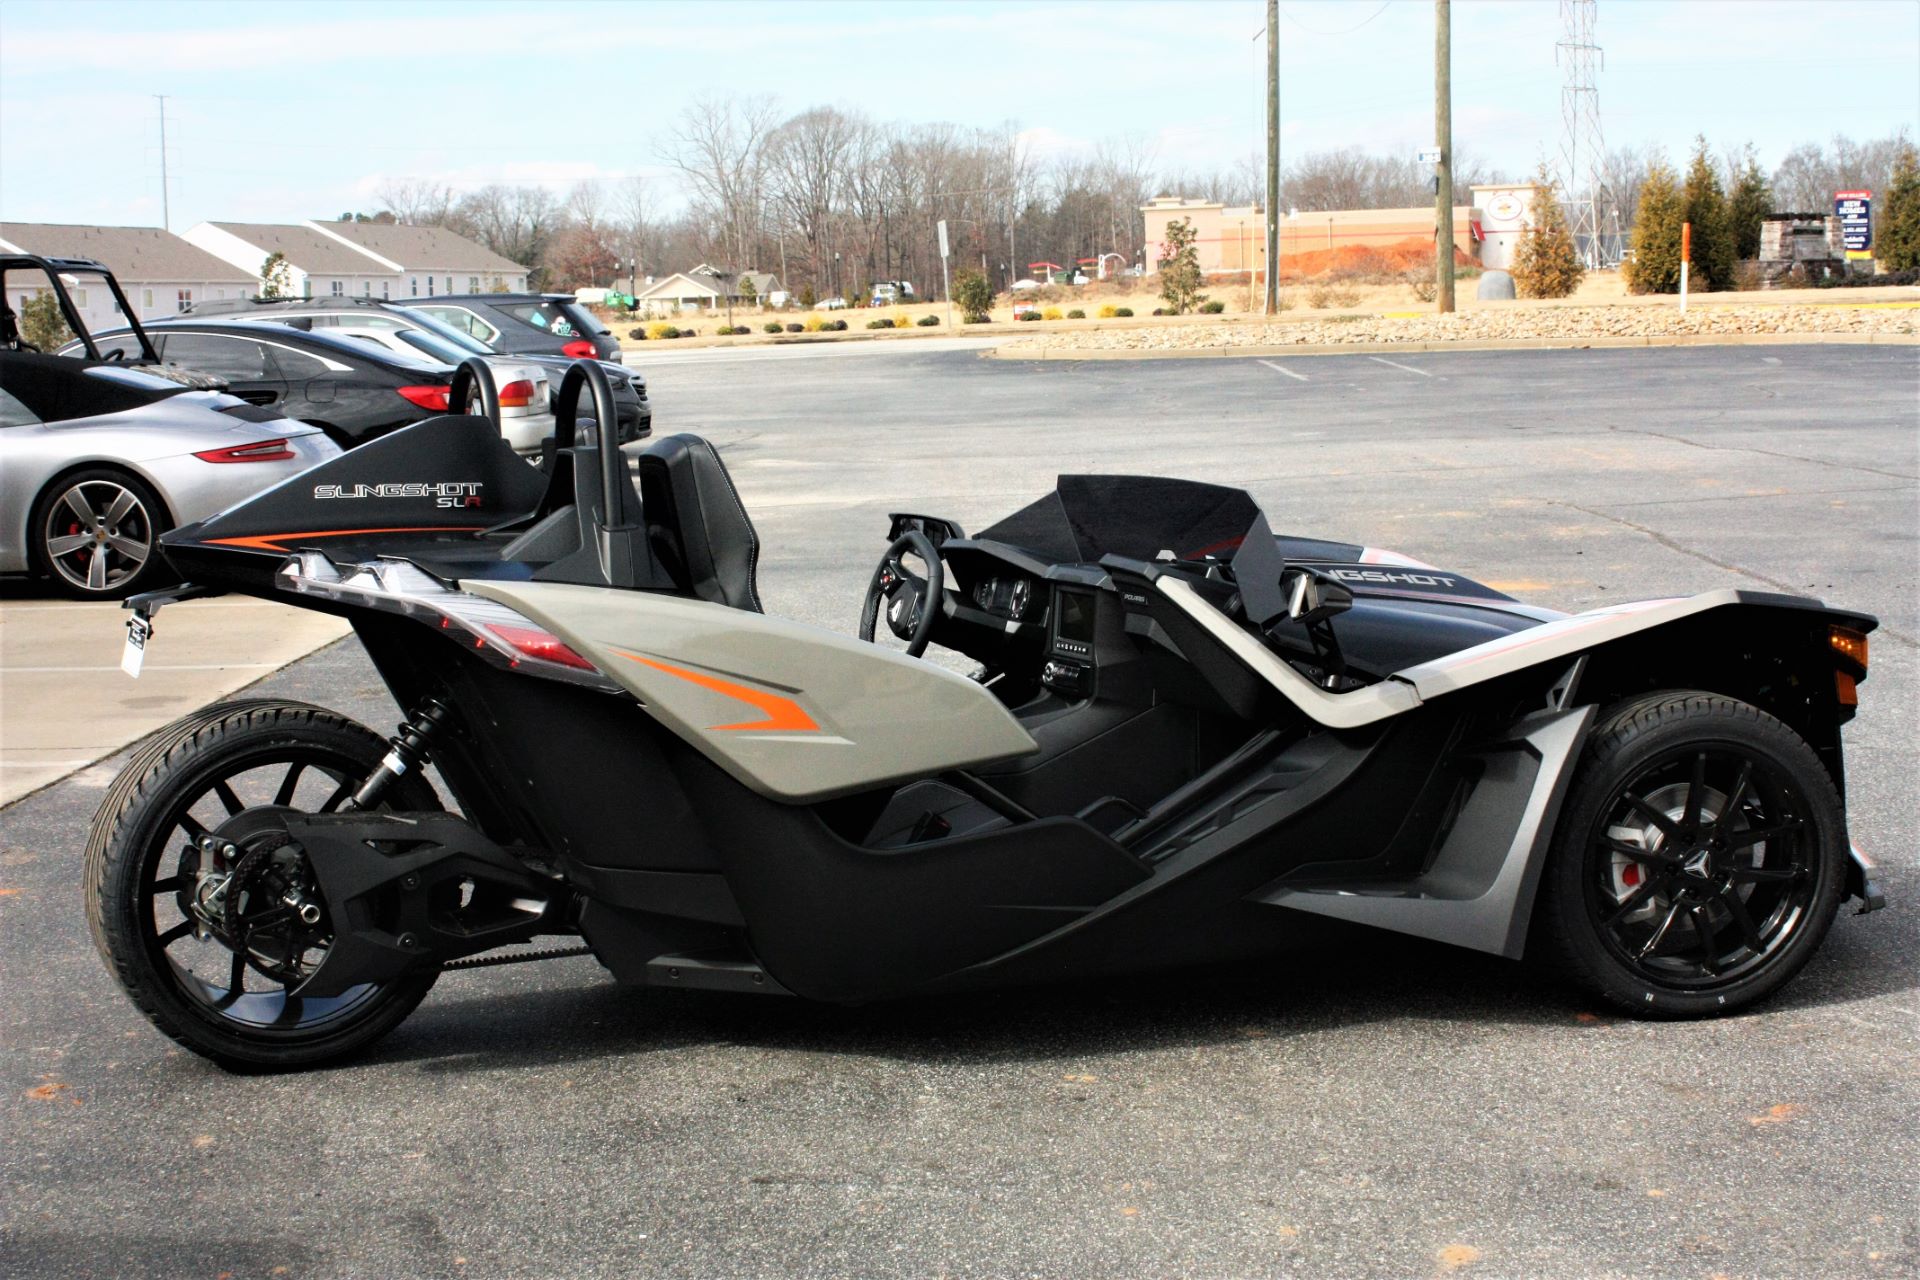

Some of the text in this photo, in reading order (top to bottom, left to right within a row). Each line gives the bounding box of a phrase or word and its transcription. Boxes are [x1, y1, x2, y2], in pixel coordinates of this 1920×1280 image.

[314, 482, 483, 499] SLINGSHOT
[436, 496, 481, 508] SLR
[1124, 593, 1145, 602] POLARIS
